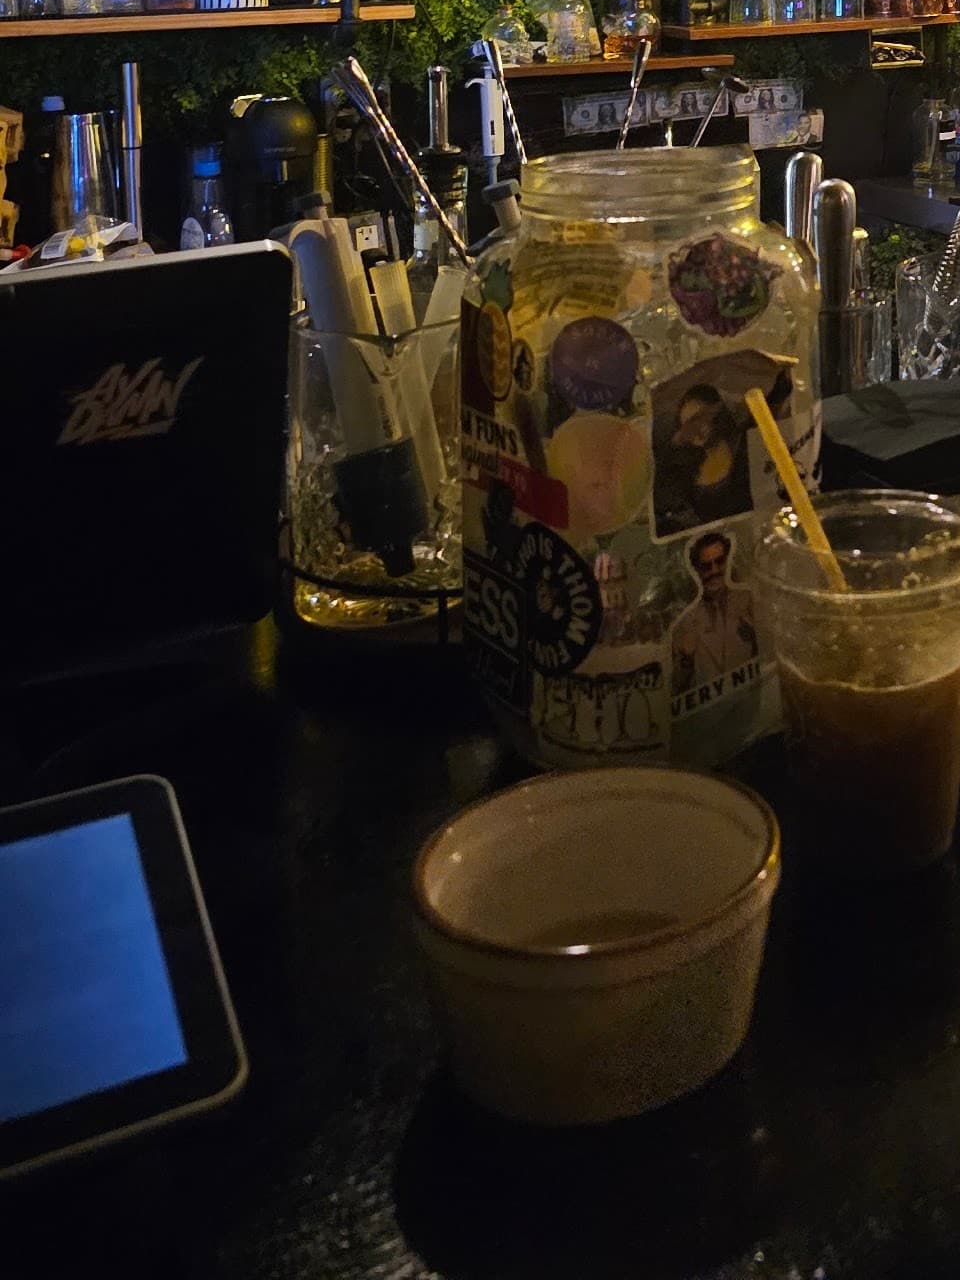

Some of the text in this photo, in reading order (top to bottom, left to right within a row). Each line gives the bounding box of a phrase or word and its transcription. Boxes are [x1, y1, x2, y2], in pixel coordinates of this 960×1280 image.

[537, 531, 554, 559] IS
[557, 552, 594, 646] THOM
[671, 677, 725, 717] VERY
[730, 660, 761, 689] NI
